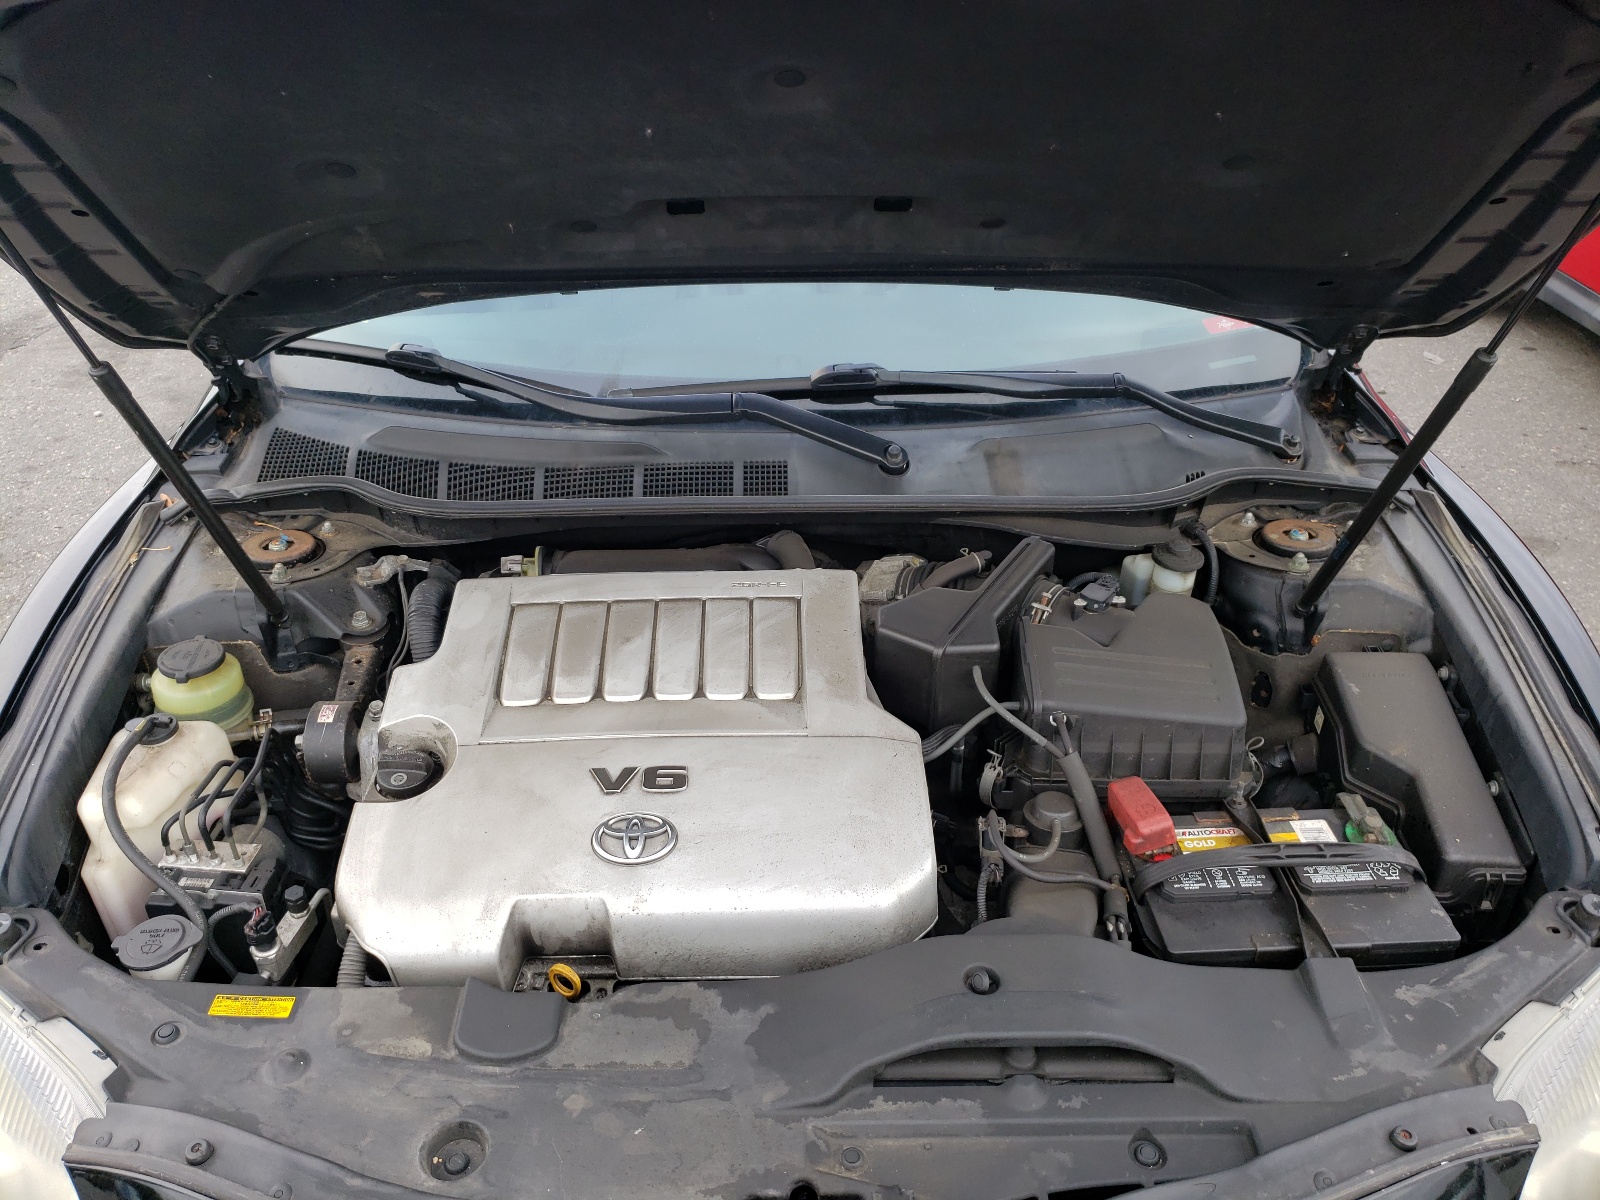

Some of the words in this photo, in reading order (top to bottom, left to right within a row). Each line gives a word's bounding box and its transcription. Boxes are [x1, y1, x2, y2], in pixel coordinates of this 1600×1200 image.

[589, 765, 689, 794] V6
[1188, 828, 1236, 837] AUTOCRAFT
[1184, 839, 1216, 848] GOLD
